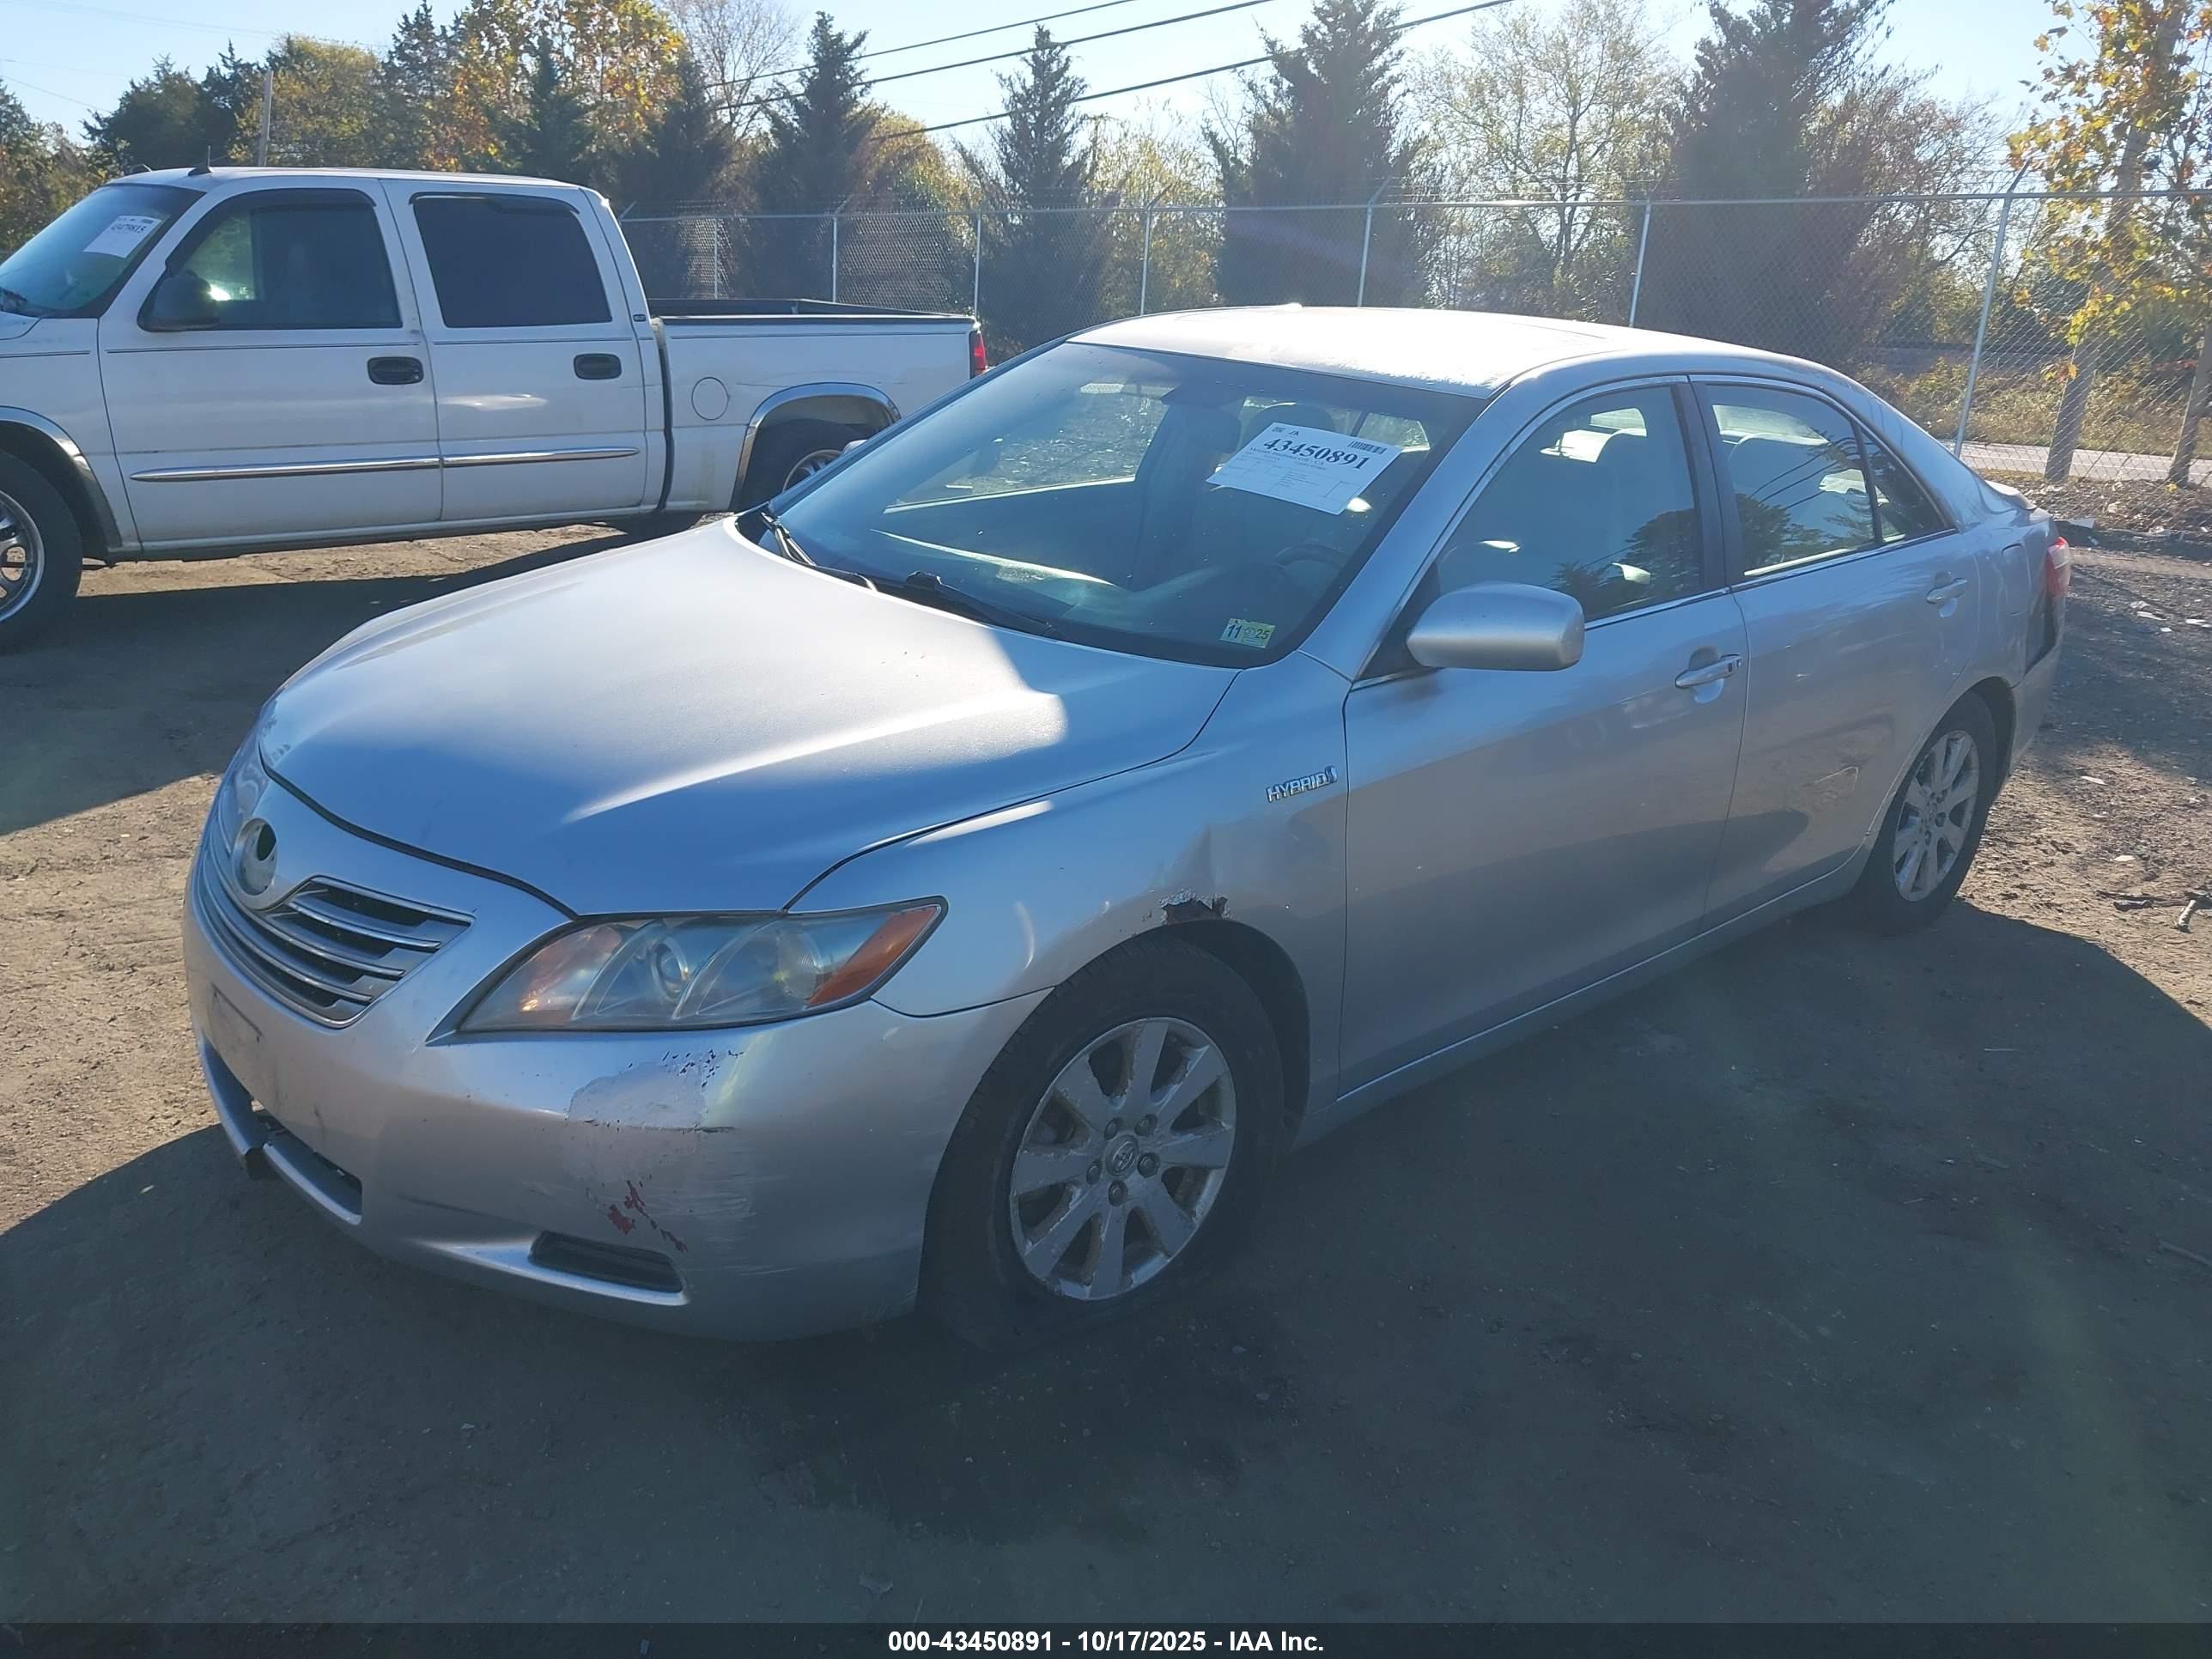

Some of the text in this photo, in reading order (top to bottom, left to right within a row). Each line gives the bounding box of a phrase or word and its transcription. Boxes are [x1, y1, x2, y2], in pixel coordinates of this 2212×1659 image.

[1263, 438, 1370, 470] 43450891
[1228, 624, 1271, 640] 11 25
[1266, 772, 1330, 803] HYBRID
